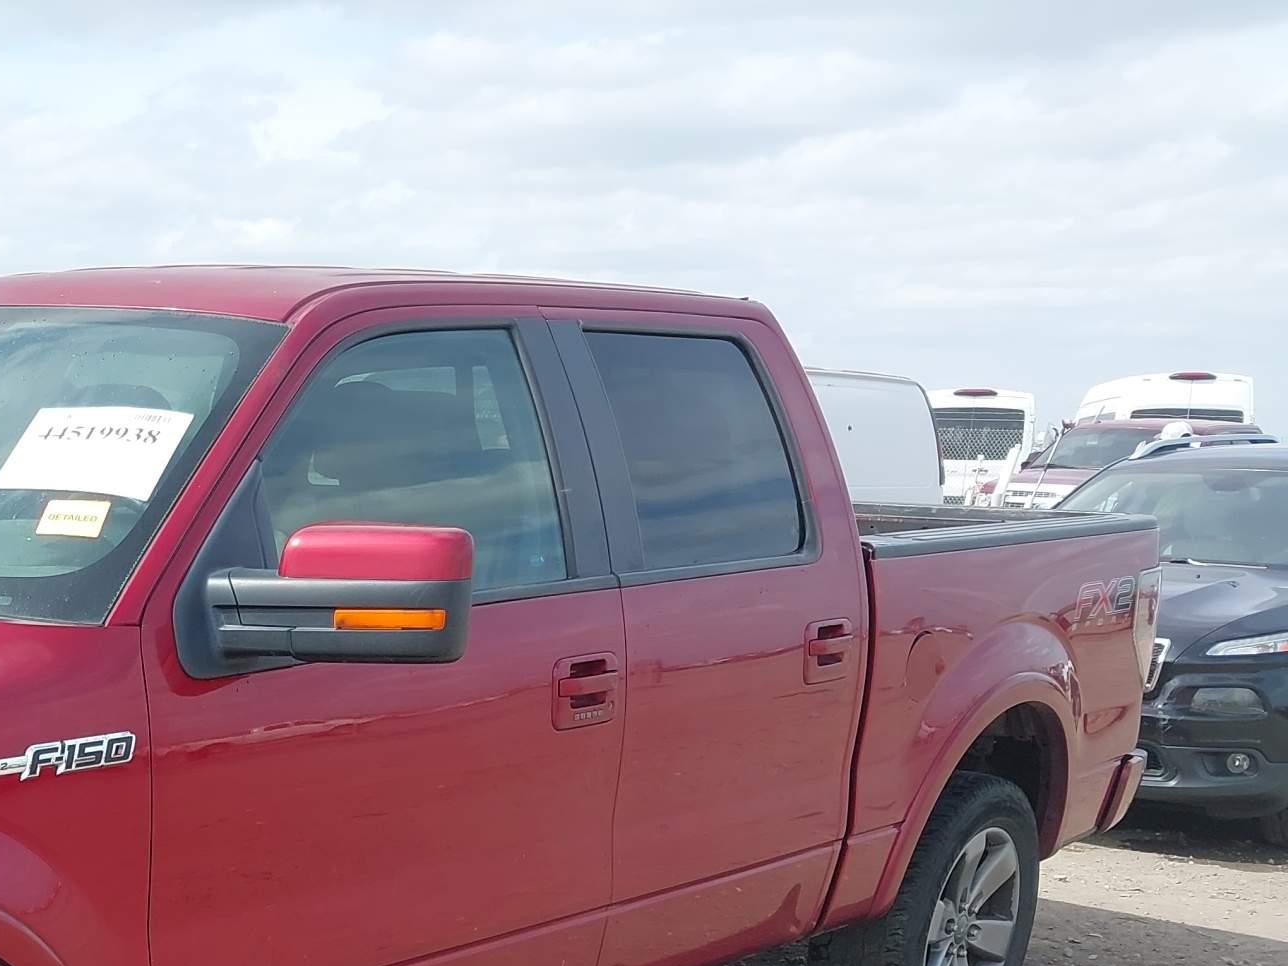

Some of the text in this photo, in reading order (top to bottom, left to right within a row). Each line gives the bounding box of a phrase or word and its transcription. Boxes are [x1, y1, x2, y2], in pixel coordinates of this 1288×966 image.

[38, 426, 161, 443] 44519938
[47, 513, 99, 522] DETAILED
[1072, 575, 1136, 621] FX2
[21, 732, 137, 781] F-150
